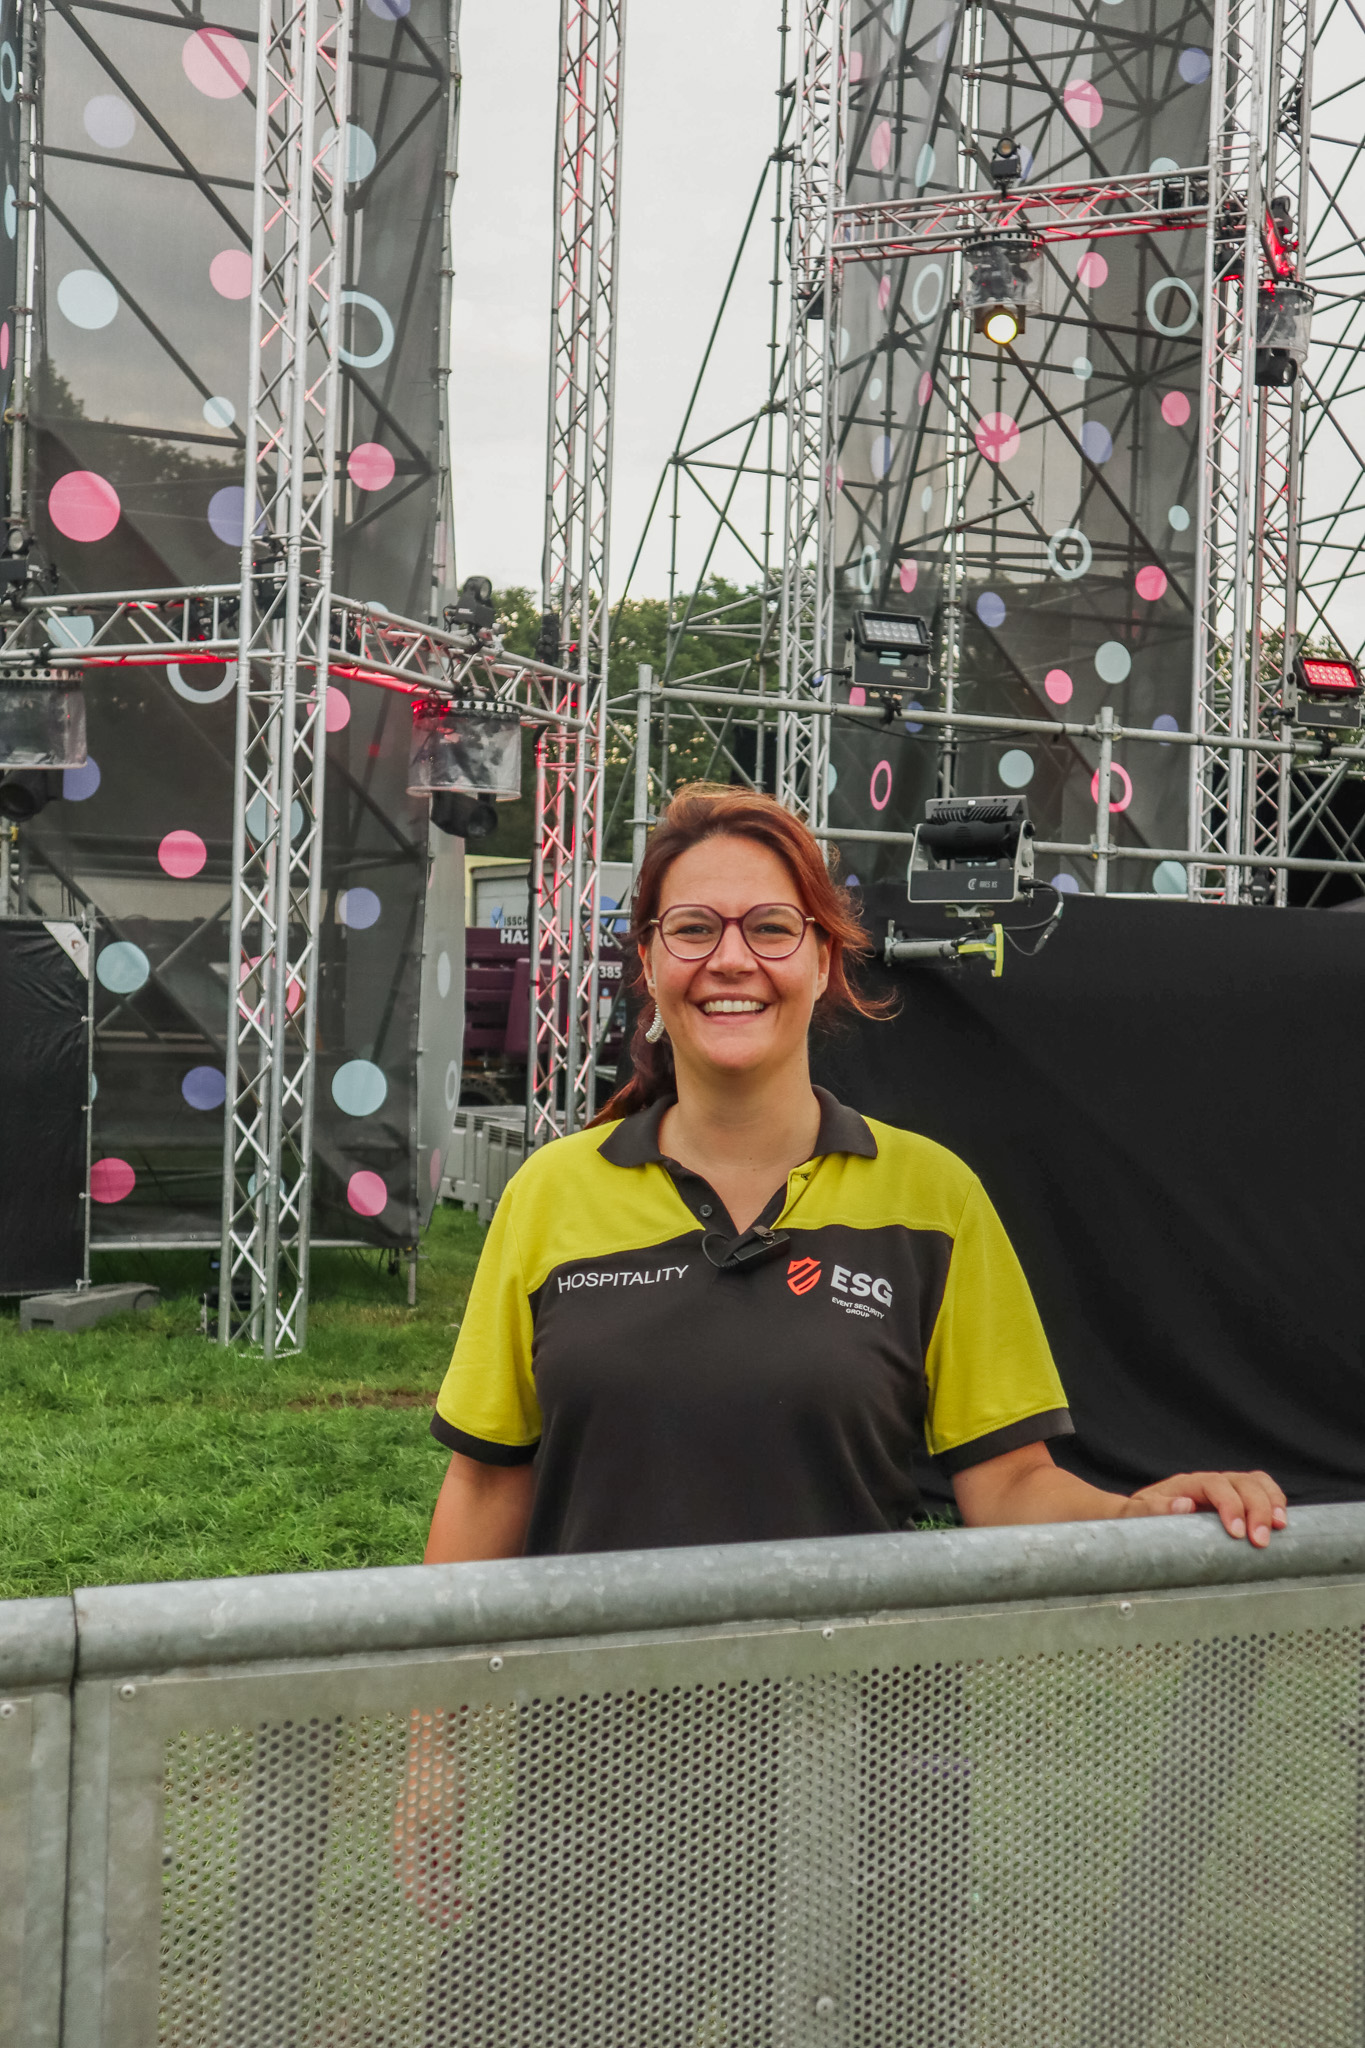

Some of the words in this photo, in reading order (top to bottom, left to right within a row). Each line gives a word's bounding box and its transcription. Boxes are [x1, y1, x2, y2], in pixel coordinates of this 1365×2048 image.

[557, 1264, 689, 1294] HOSPITALITY
[830, 1264, 893, 1308] ESG
[831, 1296, 854, 1308] EVENT
[853, 1302, 885, 1319] SECURITY
[845, 1308, 870, 1318] GROUP
